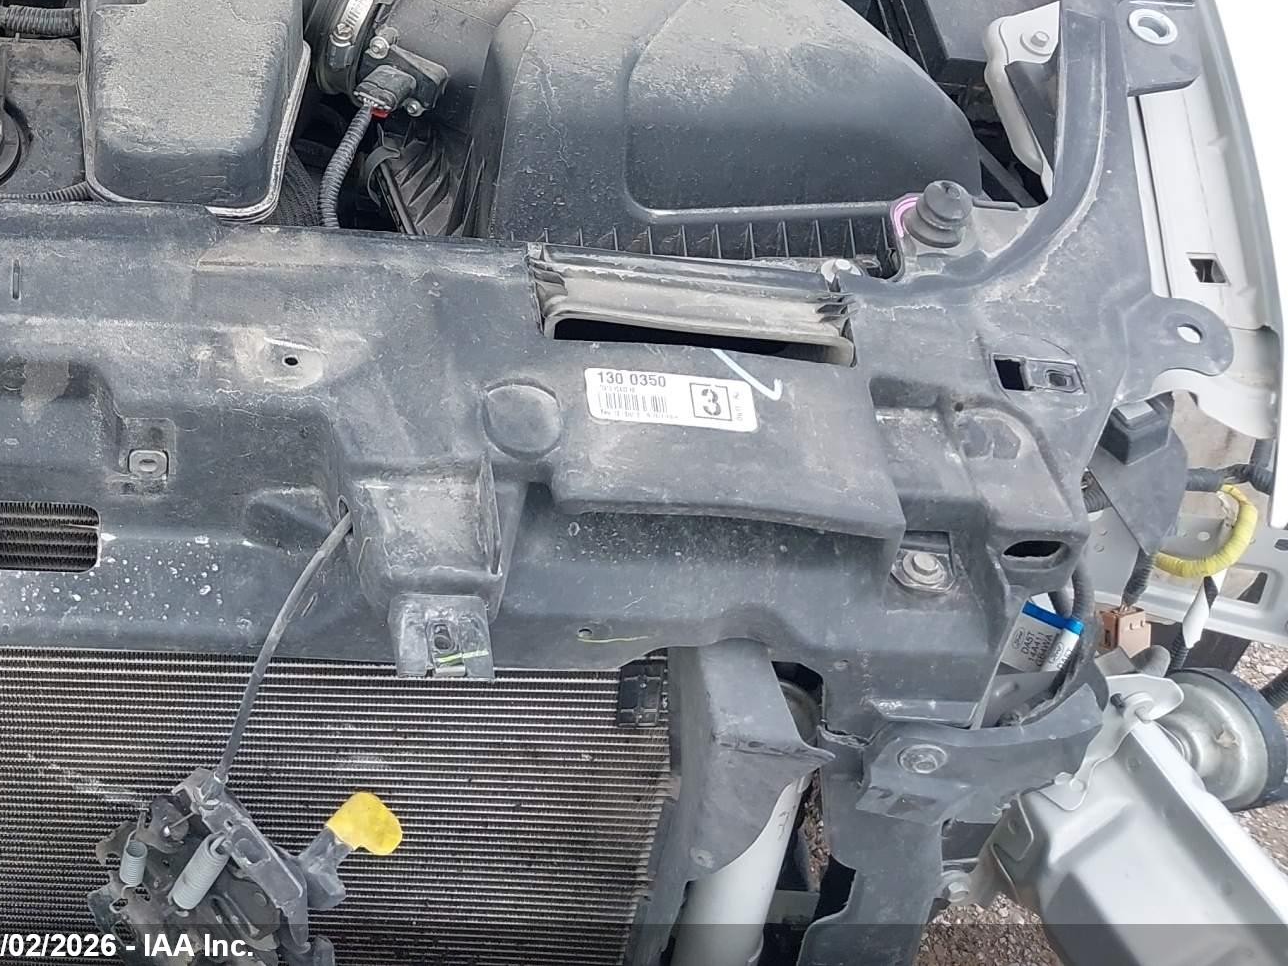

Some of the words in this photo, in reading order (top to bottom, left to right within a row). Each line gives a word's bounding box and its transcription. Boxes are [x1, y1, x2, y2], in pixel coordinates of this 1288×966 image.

[597, 371, 623, 385] 130
[630, 374, 666, 388] 0350
[701, 388, 722, 416] 3
